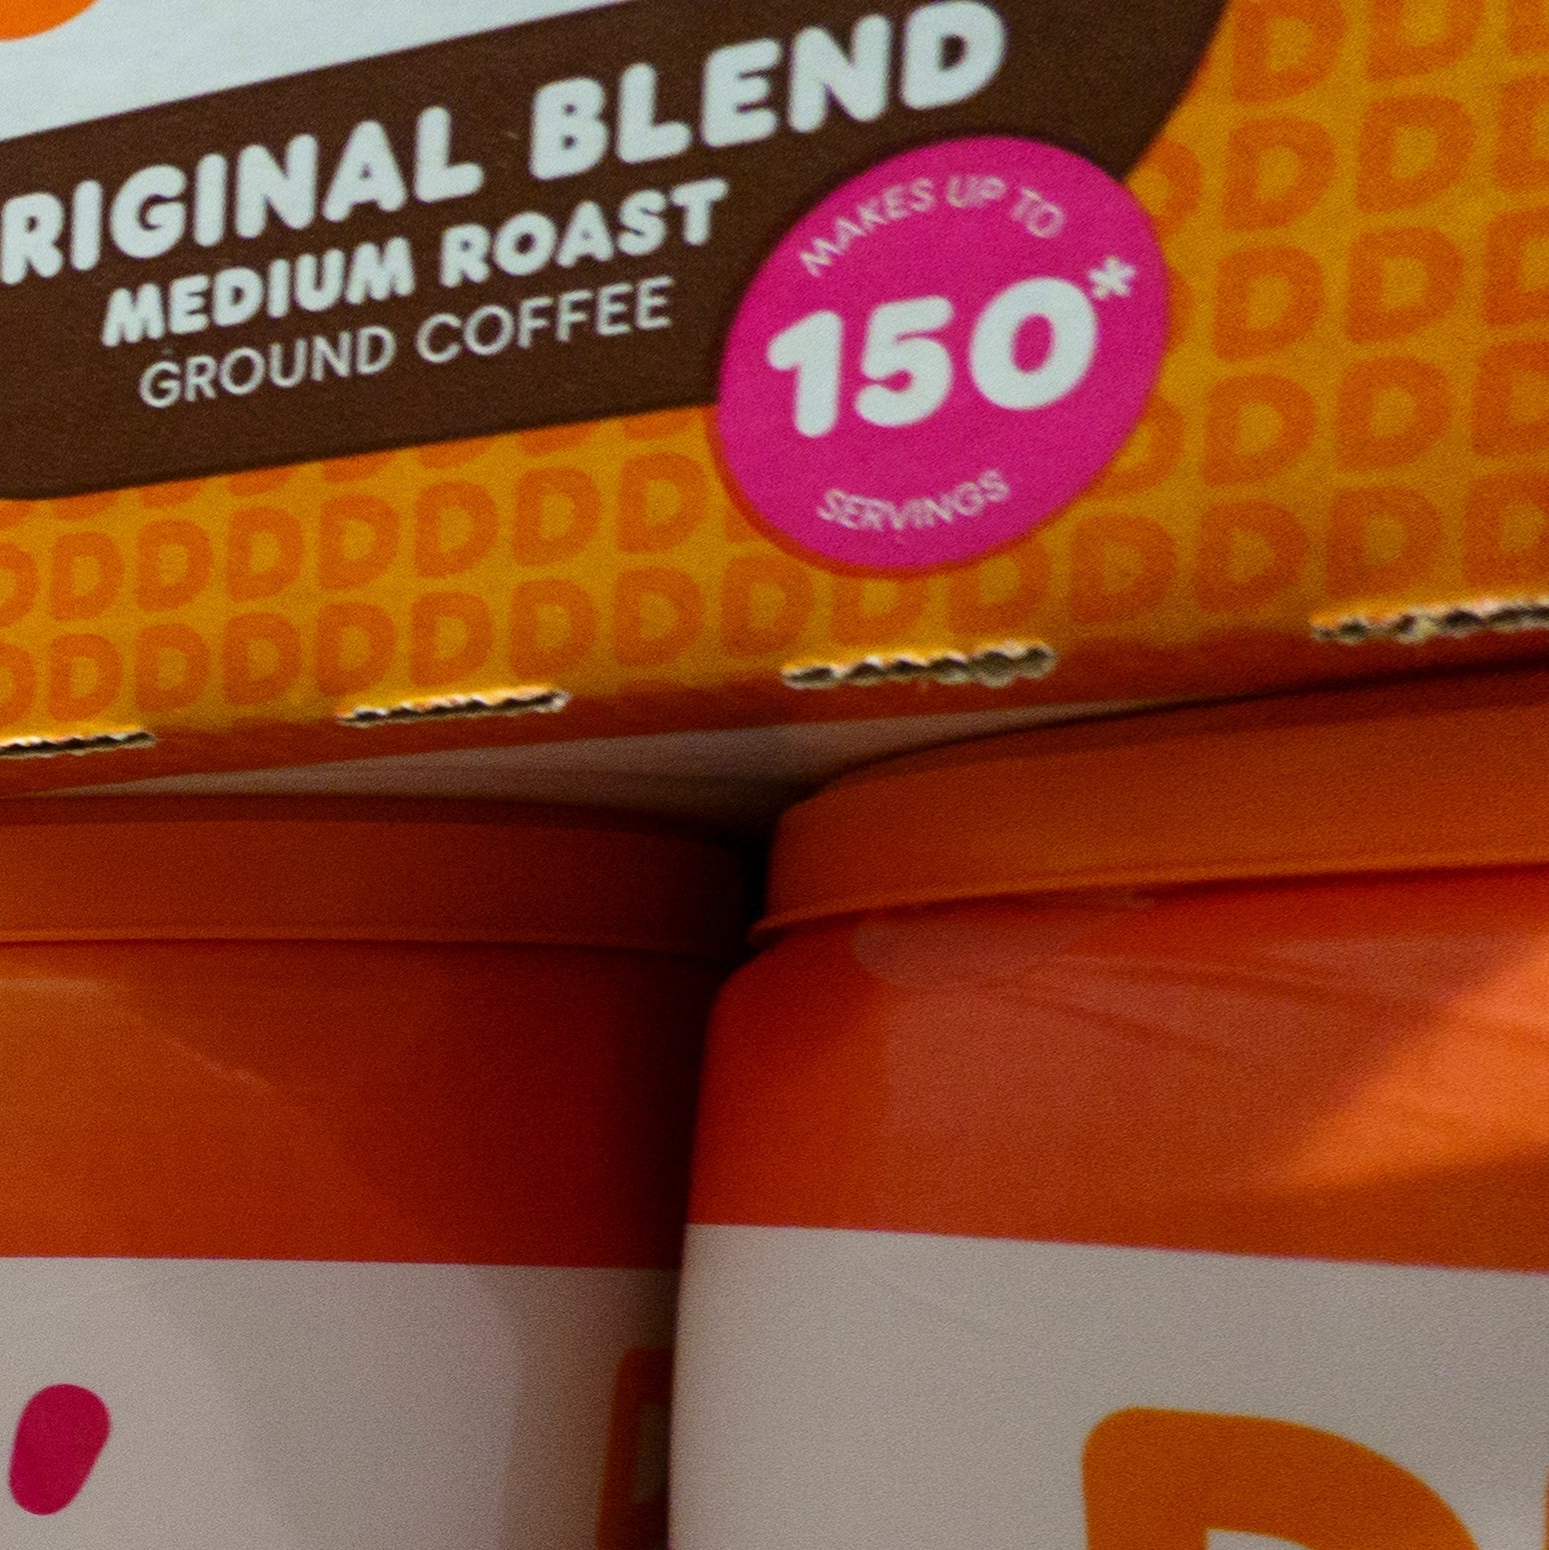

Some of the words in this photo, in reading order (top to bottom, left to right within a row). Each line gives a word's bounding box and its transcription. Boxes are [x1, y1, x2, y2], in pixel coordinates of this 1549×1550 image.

[530, 0, 1007, 180] BLEND
[102, 236, 414, 347] MEDIUM
[440, 178, 728, 289] ROAST
[800, 177, 938, 278] MAKES
[946, 175, 1006, 209] UP
[1010, 188, 1066, 240] TO
[138, 325, 396, 407] GROUND
[414, 276, 674, 366] COFFEE
[816, 469, 1011, 536] SERVINGS
